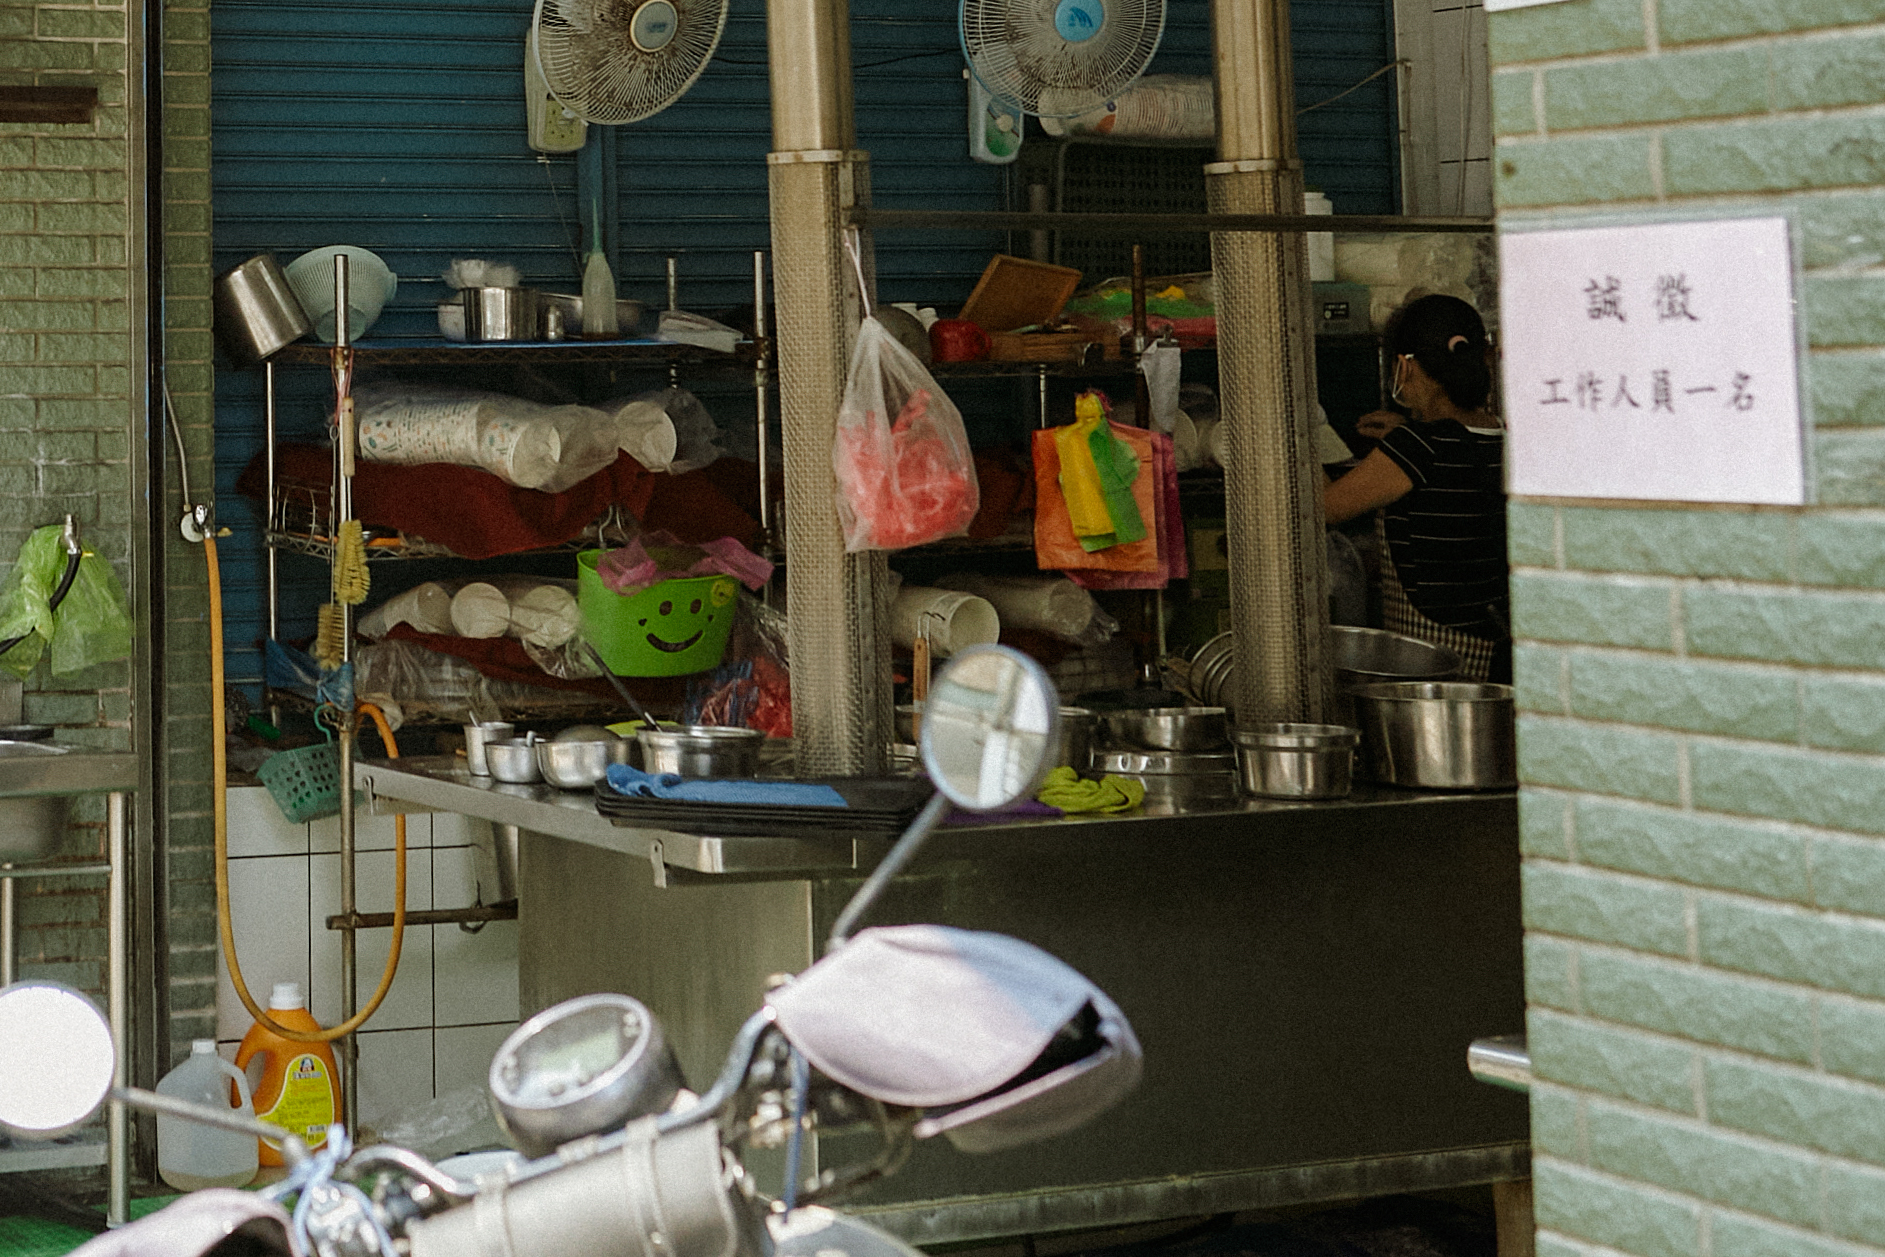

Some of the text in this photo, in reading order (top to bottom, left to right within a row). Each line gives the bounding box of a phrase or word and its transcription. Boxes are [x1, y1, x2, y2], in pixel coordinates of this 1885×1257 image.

[1540, 368, 1755, 414] 工作人員一名
